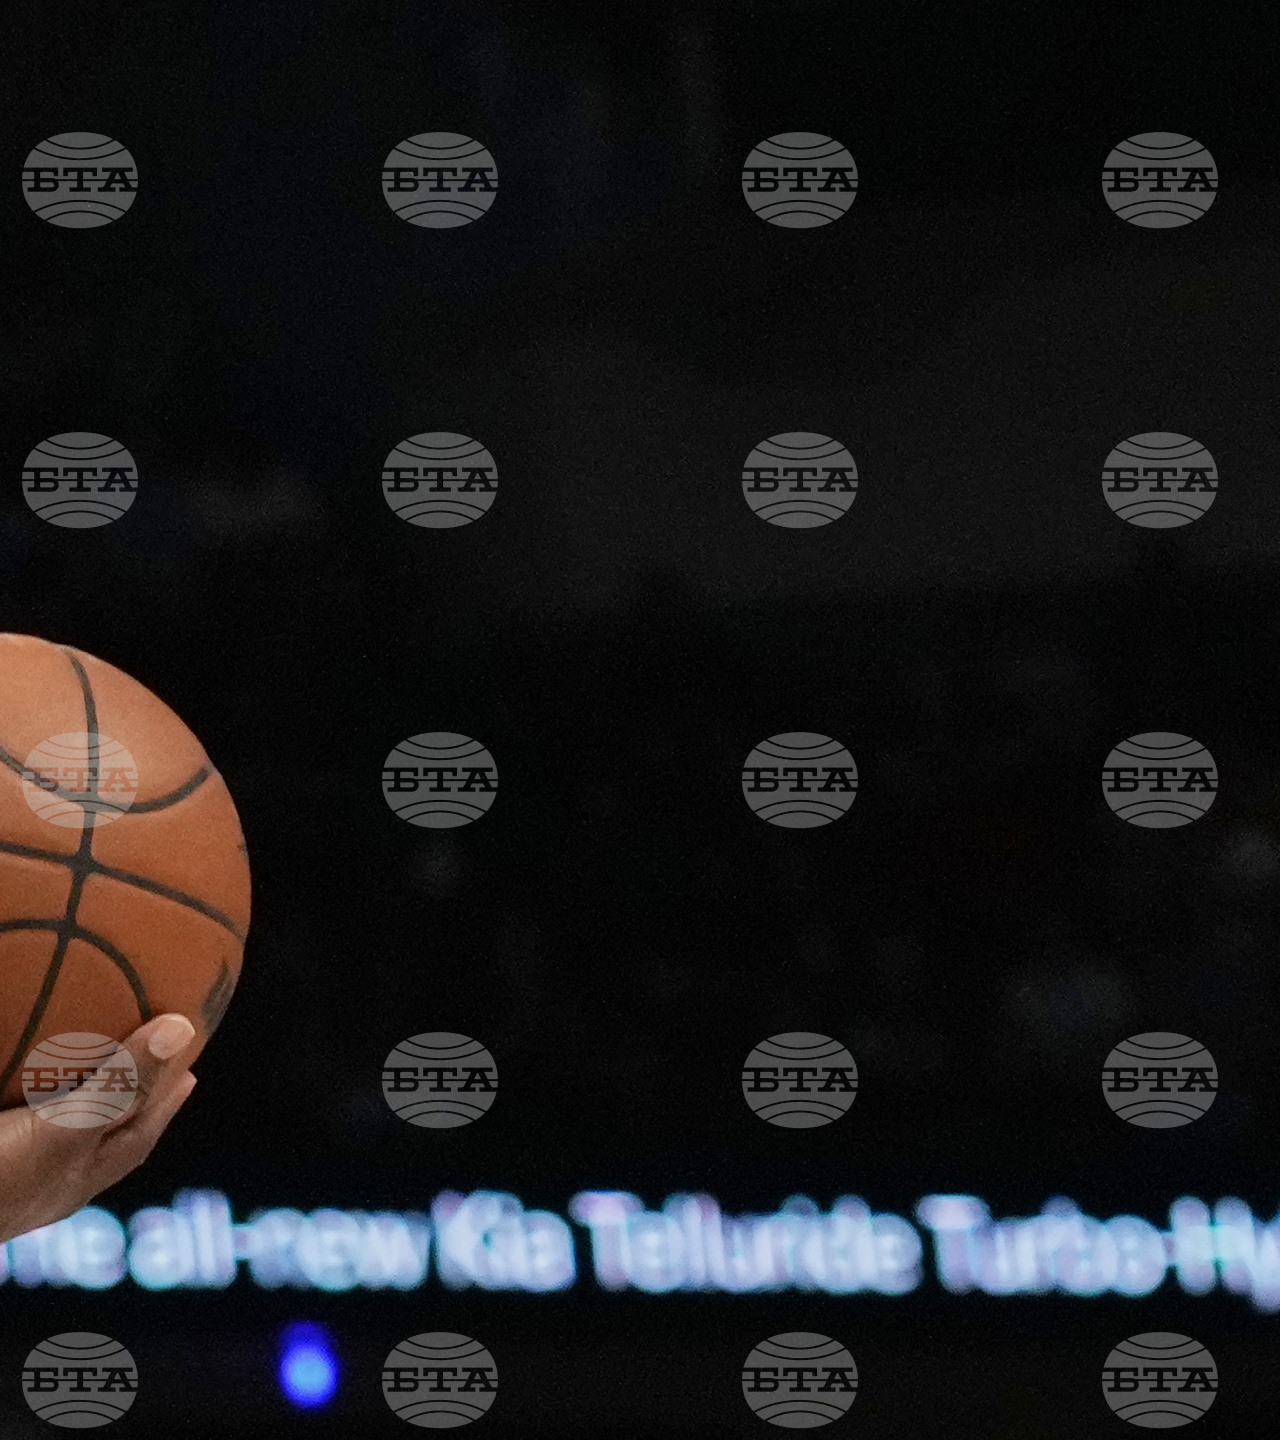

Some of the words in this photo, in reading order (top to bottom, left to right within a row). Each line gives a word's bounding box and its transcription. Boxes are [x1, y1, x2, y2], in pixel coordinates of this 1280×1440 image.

[130, 1187, 432, 1292] all-new
[433, 1190, 578, 1292] Kia
[572, 1190, 924, 1294] Telluride
